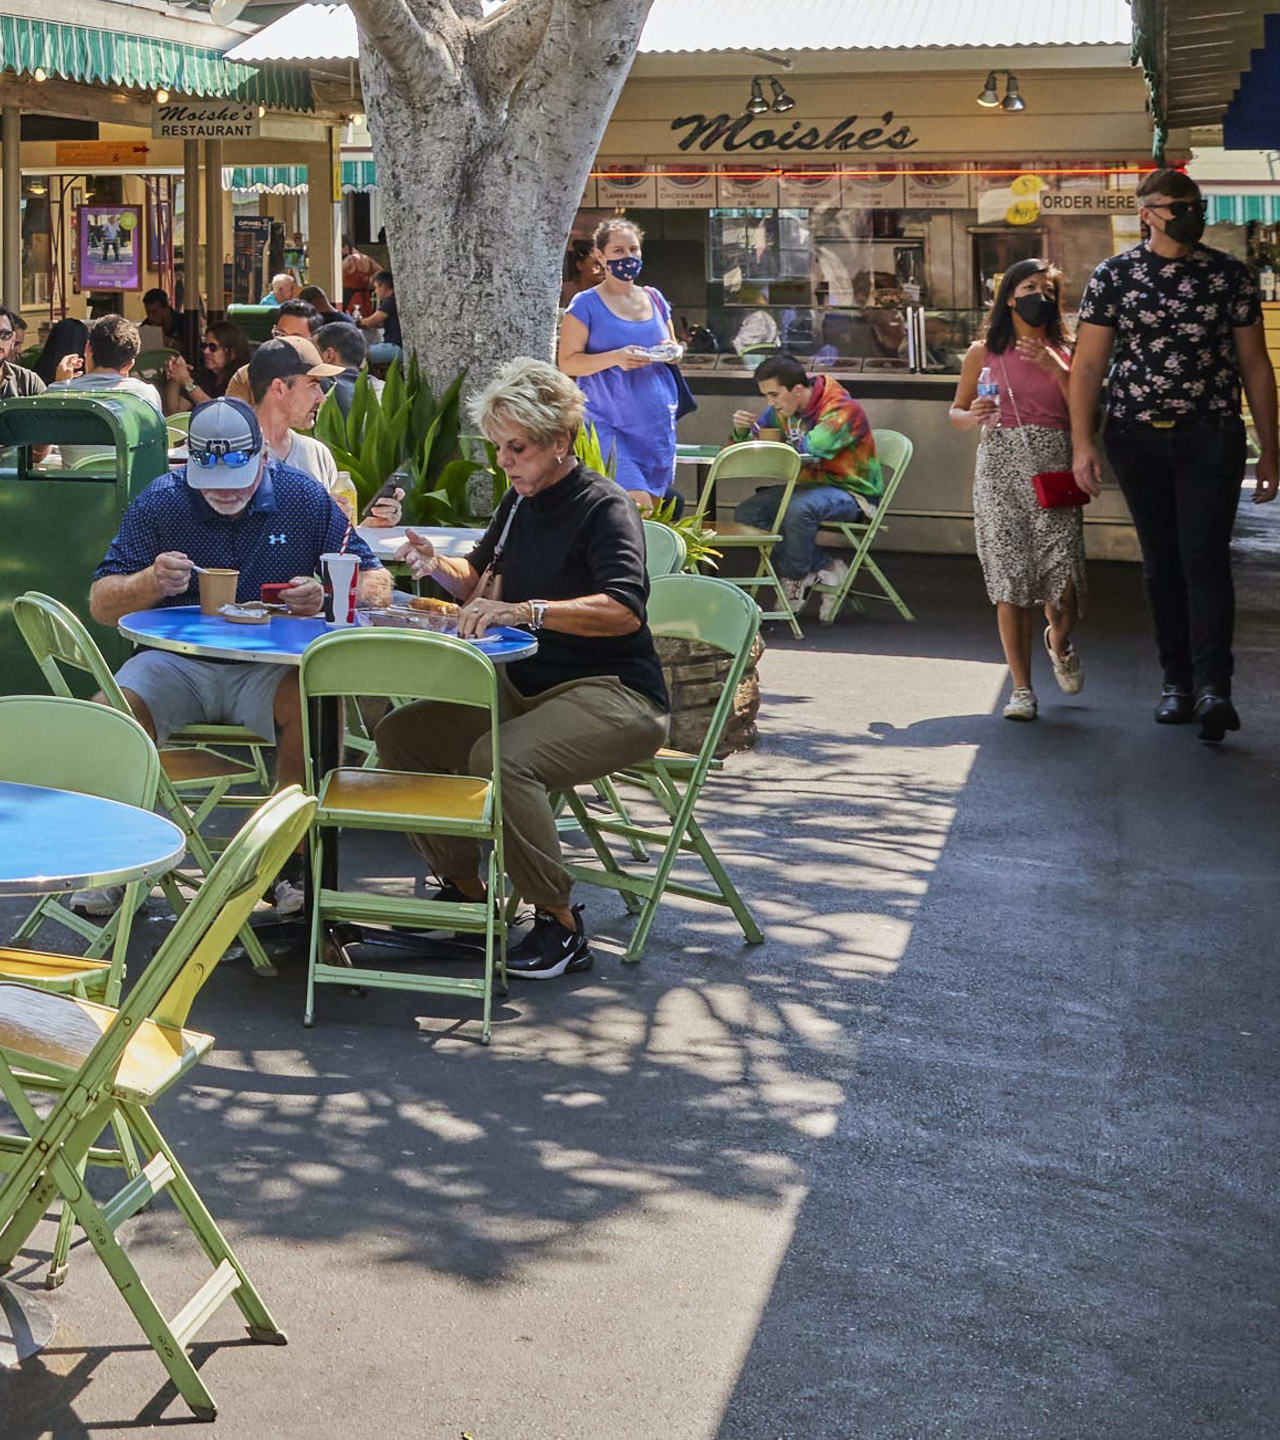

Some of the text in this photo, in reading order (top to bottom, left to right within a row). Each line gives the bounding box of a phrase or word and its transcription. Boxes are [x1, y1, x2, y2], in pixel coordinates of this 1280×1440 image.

[158, 105, 255, 122] Moishe's
[161, 125, 253, 136] RESTAURANT
[670, 111, 918, 152] Moishe's
[1042, 195, 1136, 209] ORDER HERE
